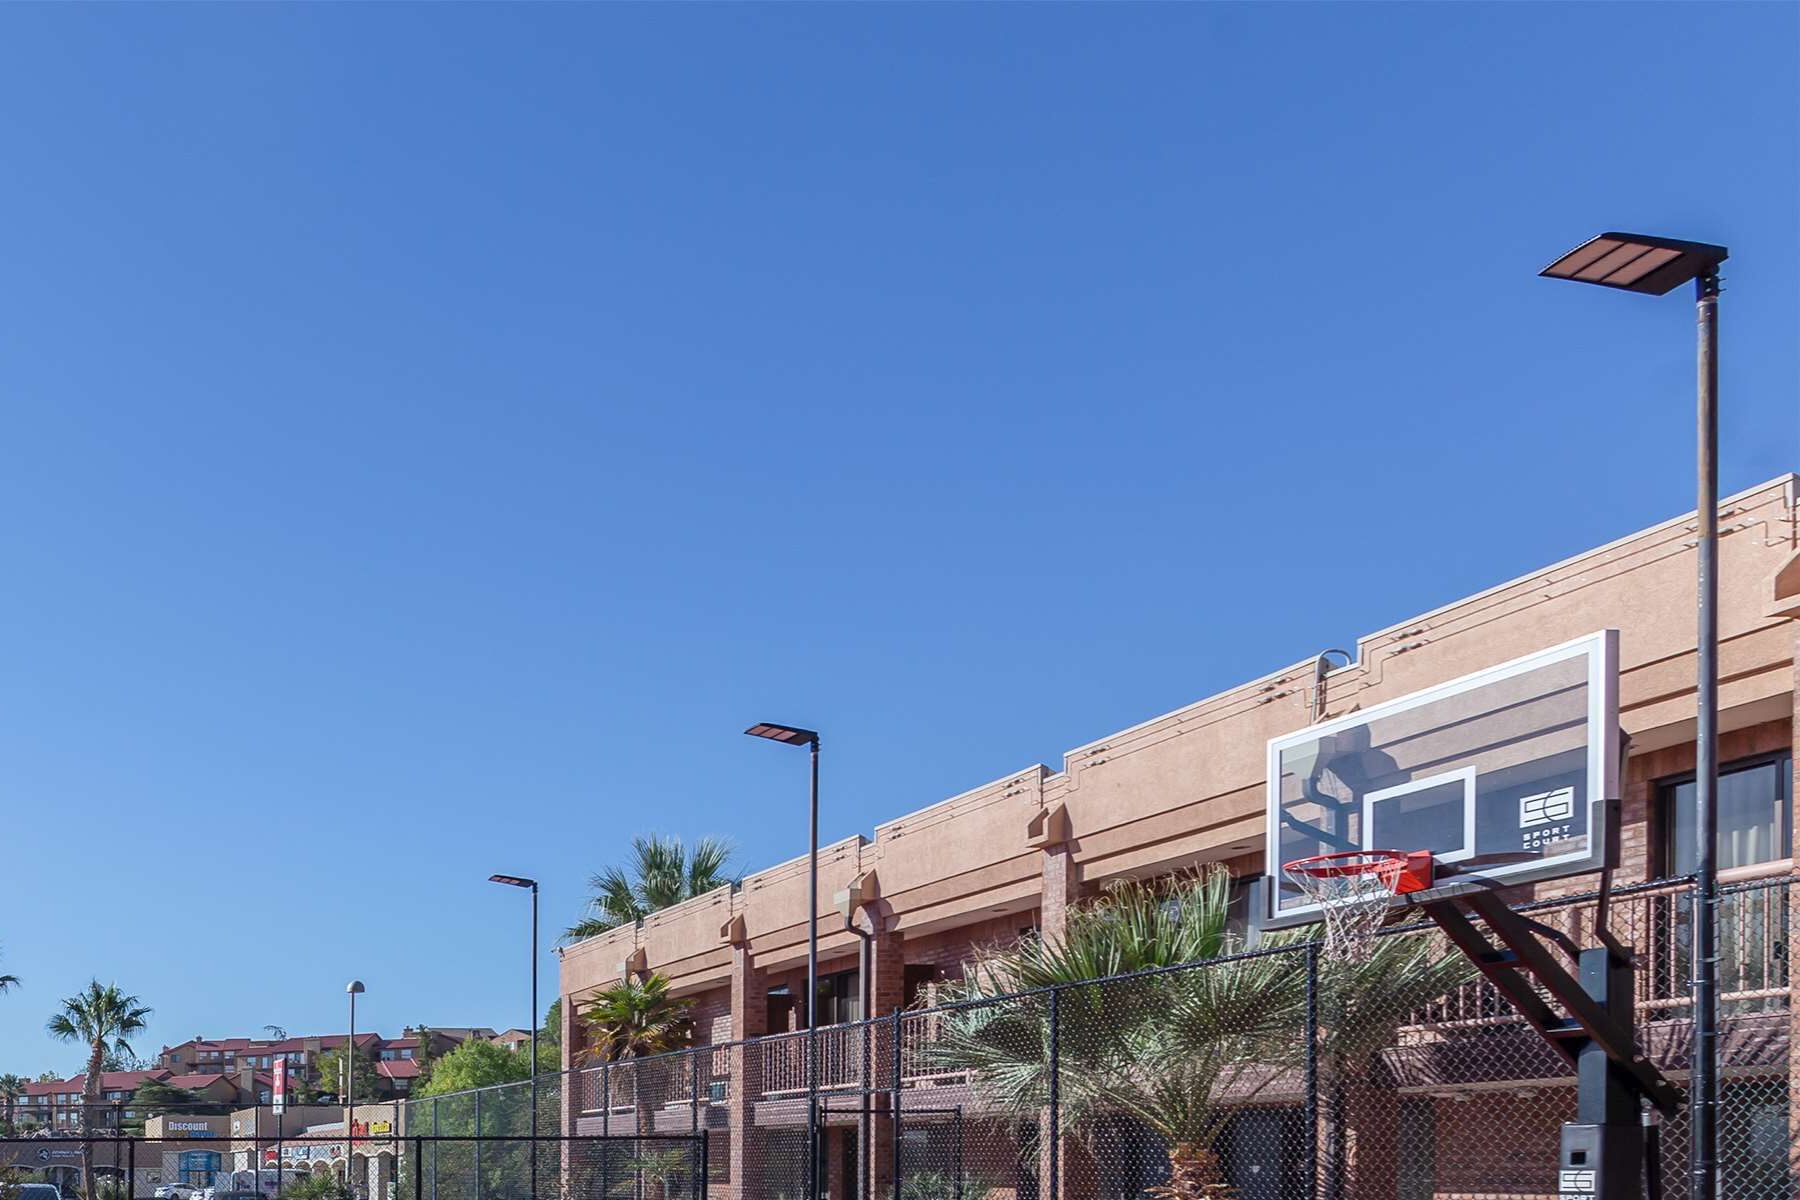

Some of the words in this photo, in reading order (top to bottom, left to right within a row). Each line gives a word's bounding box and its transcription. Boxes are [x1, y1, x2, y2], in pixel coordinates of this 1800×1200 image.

[1523, 824, 1570, 841] SPORT
[1523, 834, 1570, 849] COURT
[168, 1121, 208, 1131] Discount
